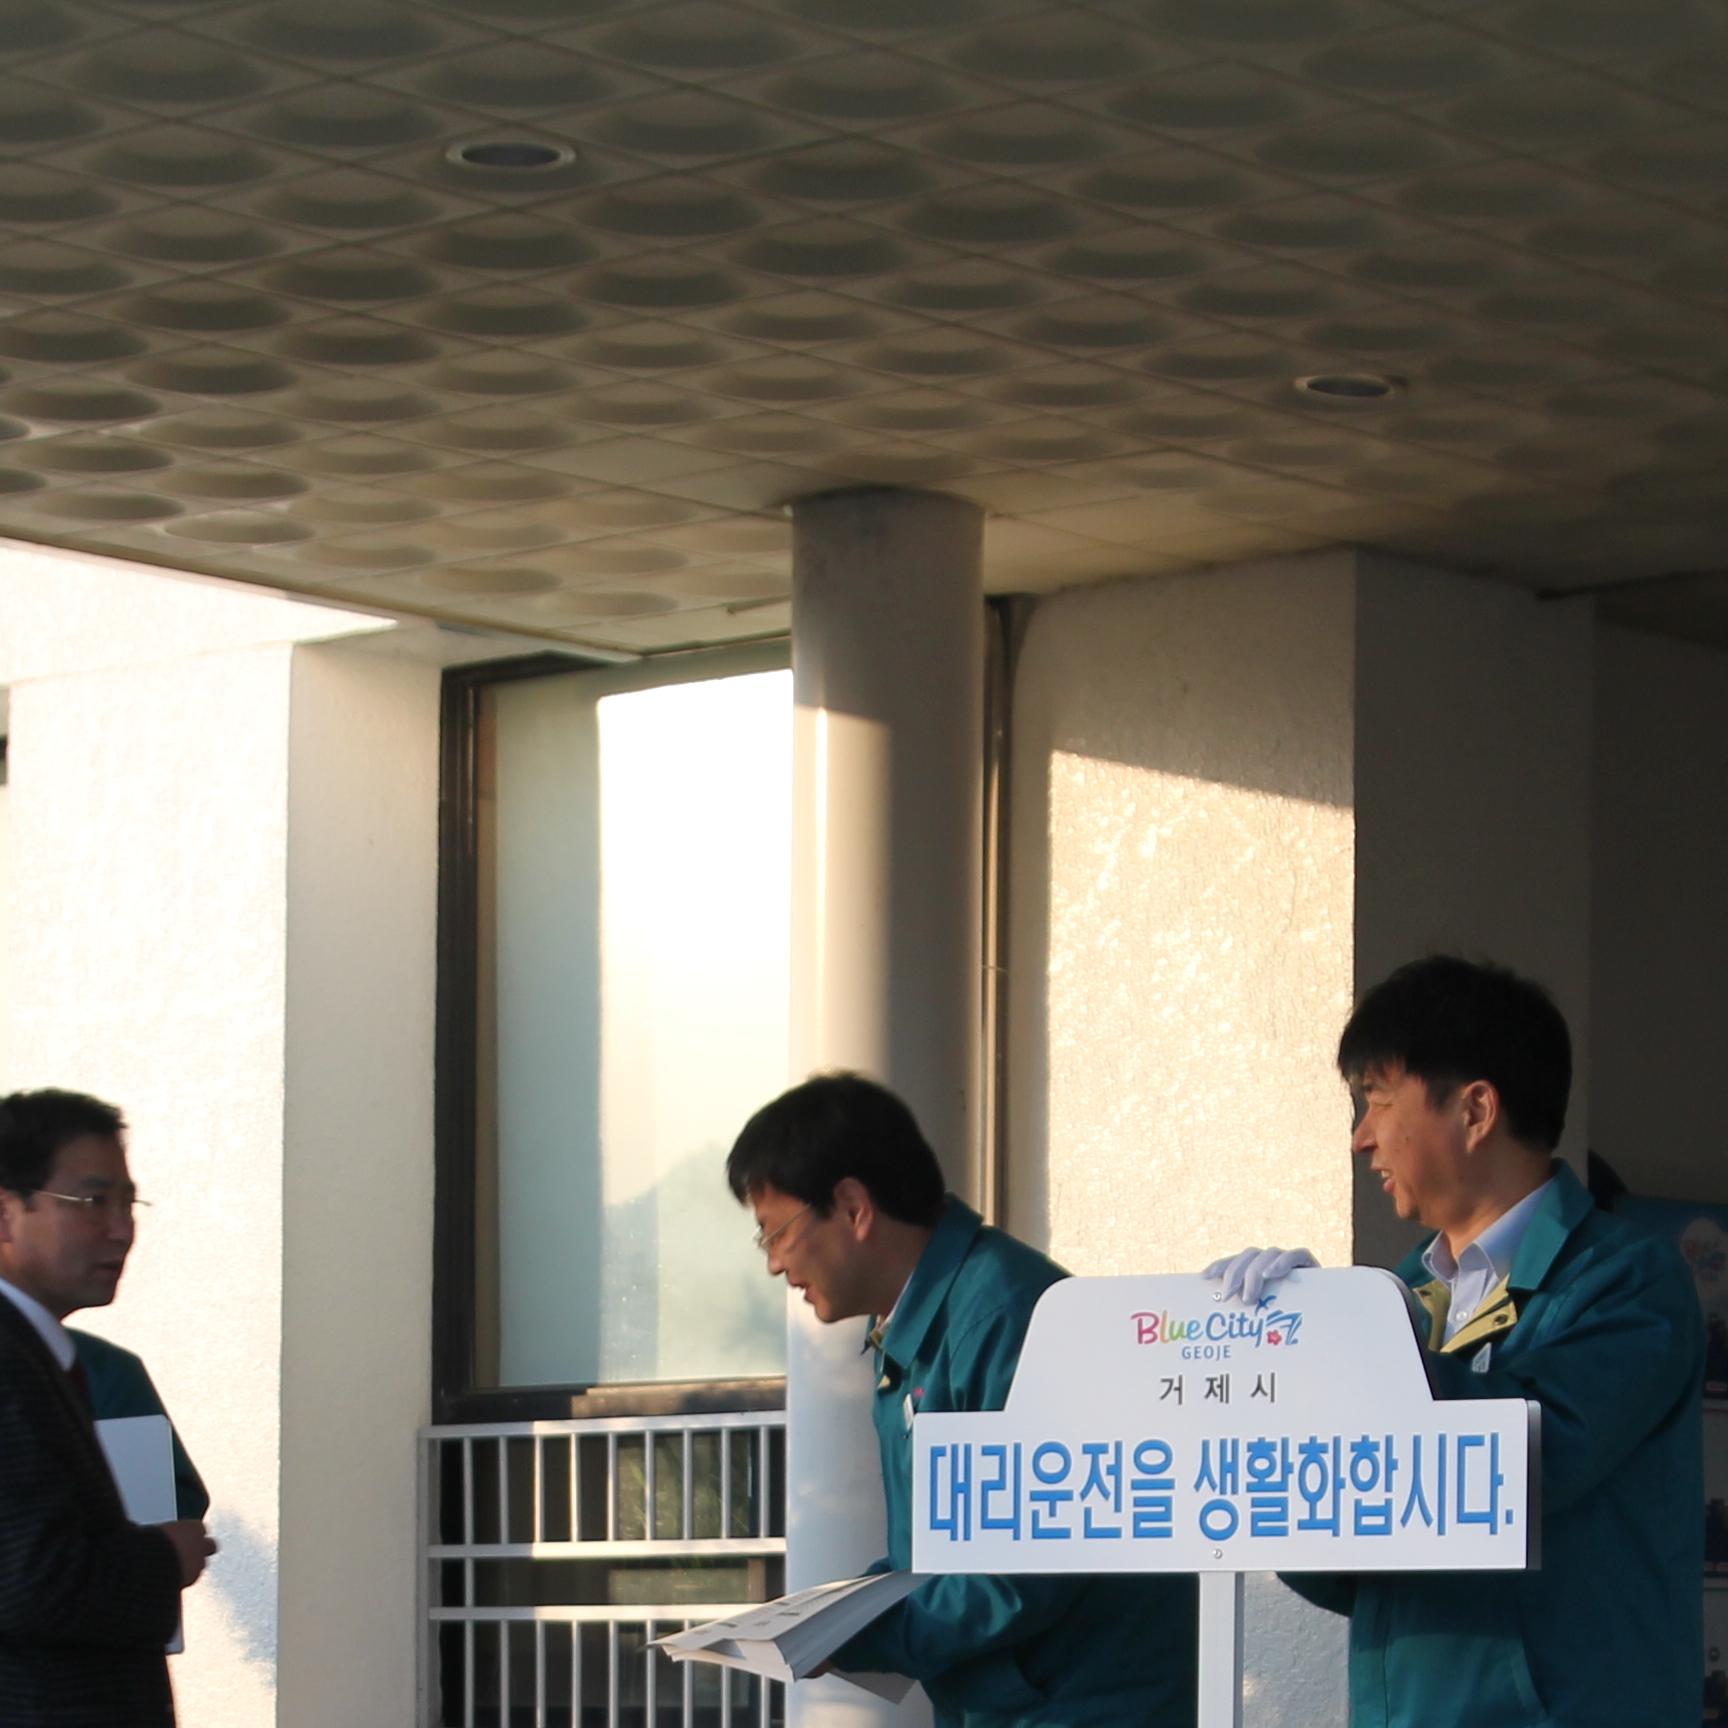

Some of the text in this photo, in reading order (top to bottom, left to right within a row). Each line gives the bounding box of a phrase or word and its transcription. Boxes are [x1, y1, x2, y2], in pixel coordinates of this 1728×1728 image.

[1181, 1344, 1232, 1361] GEOJE
[928, 1431, 1515, 1542] 대리운전을 생활화합시다.
